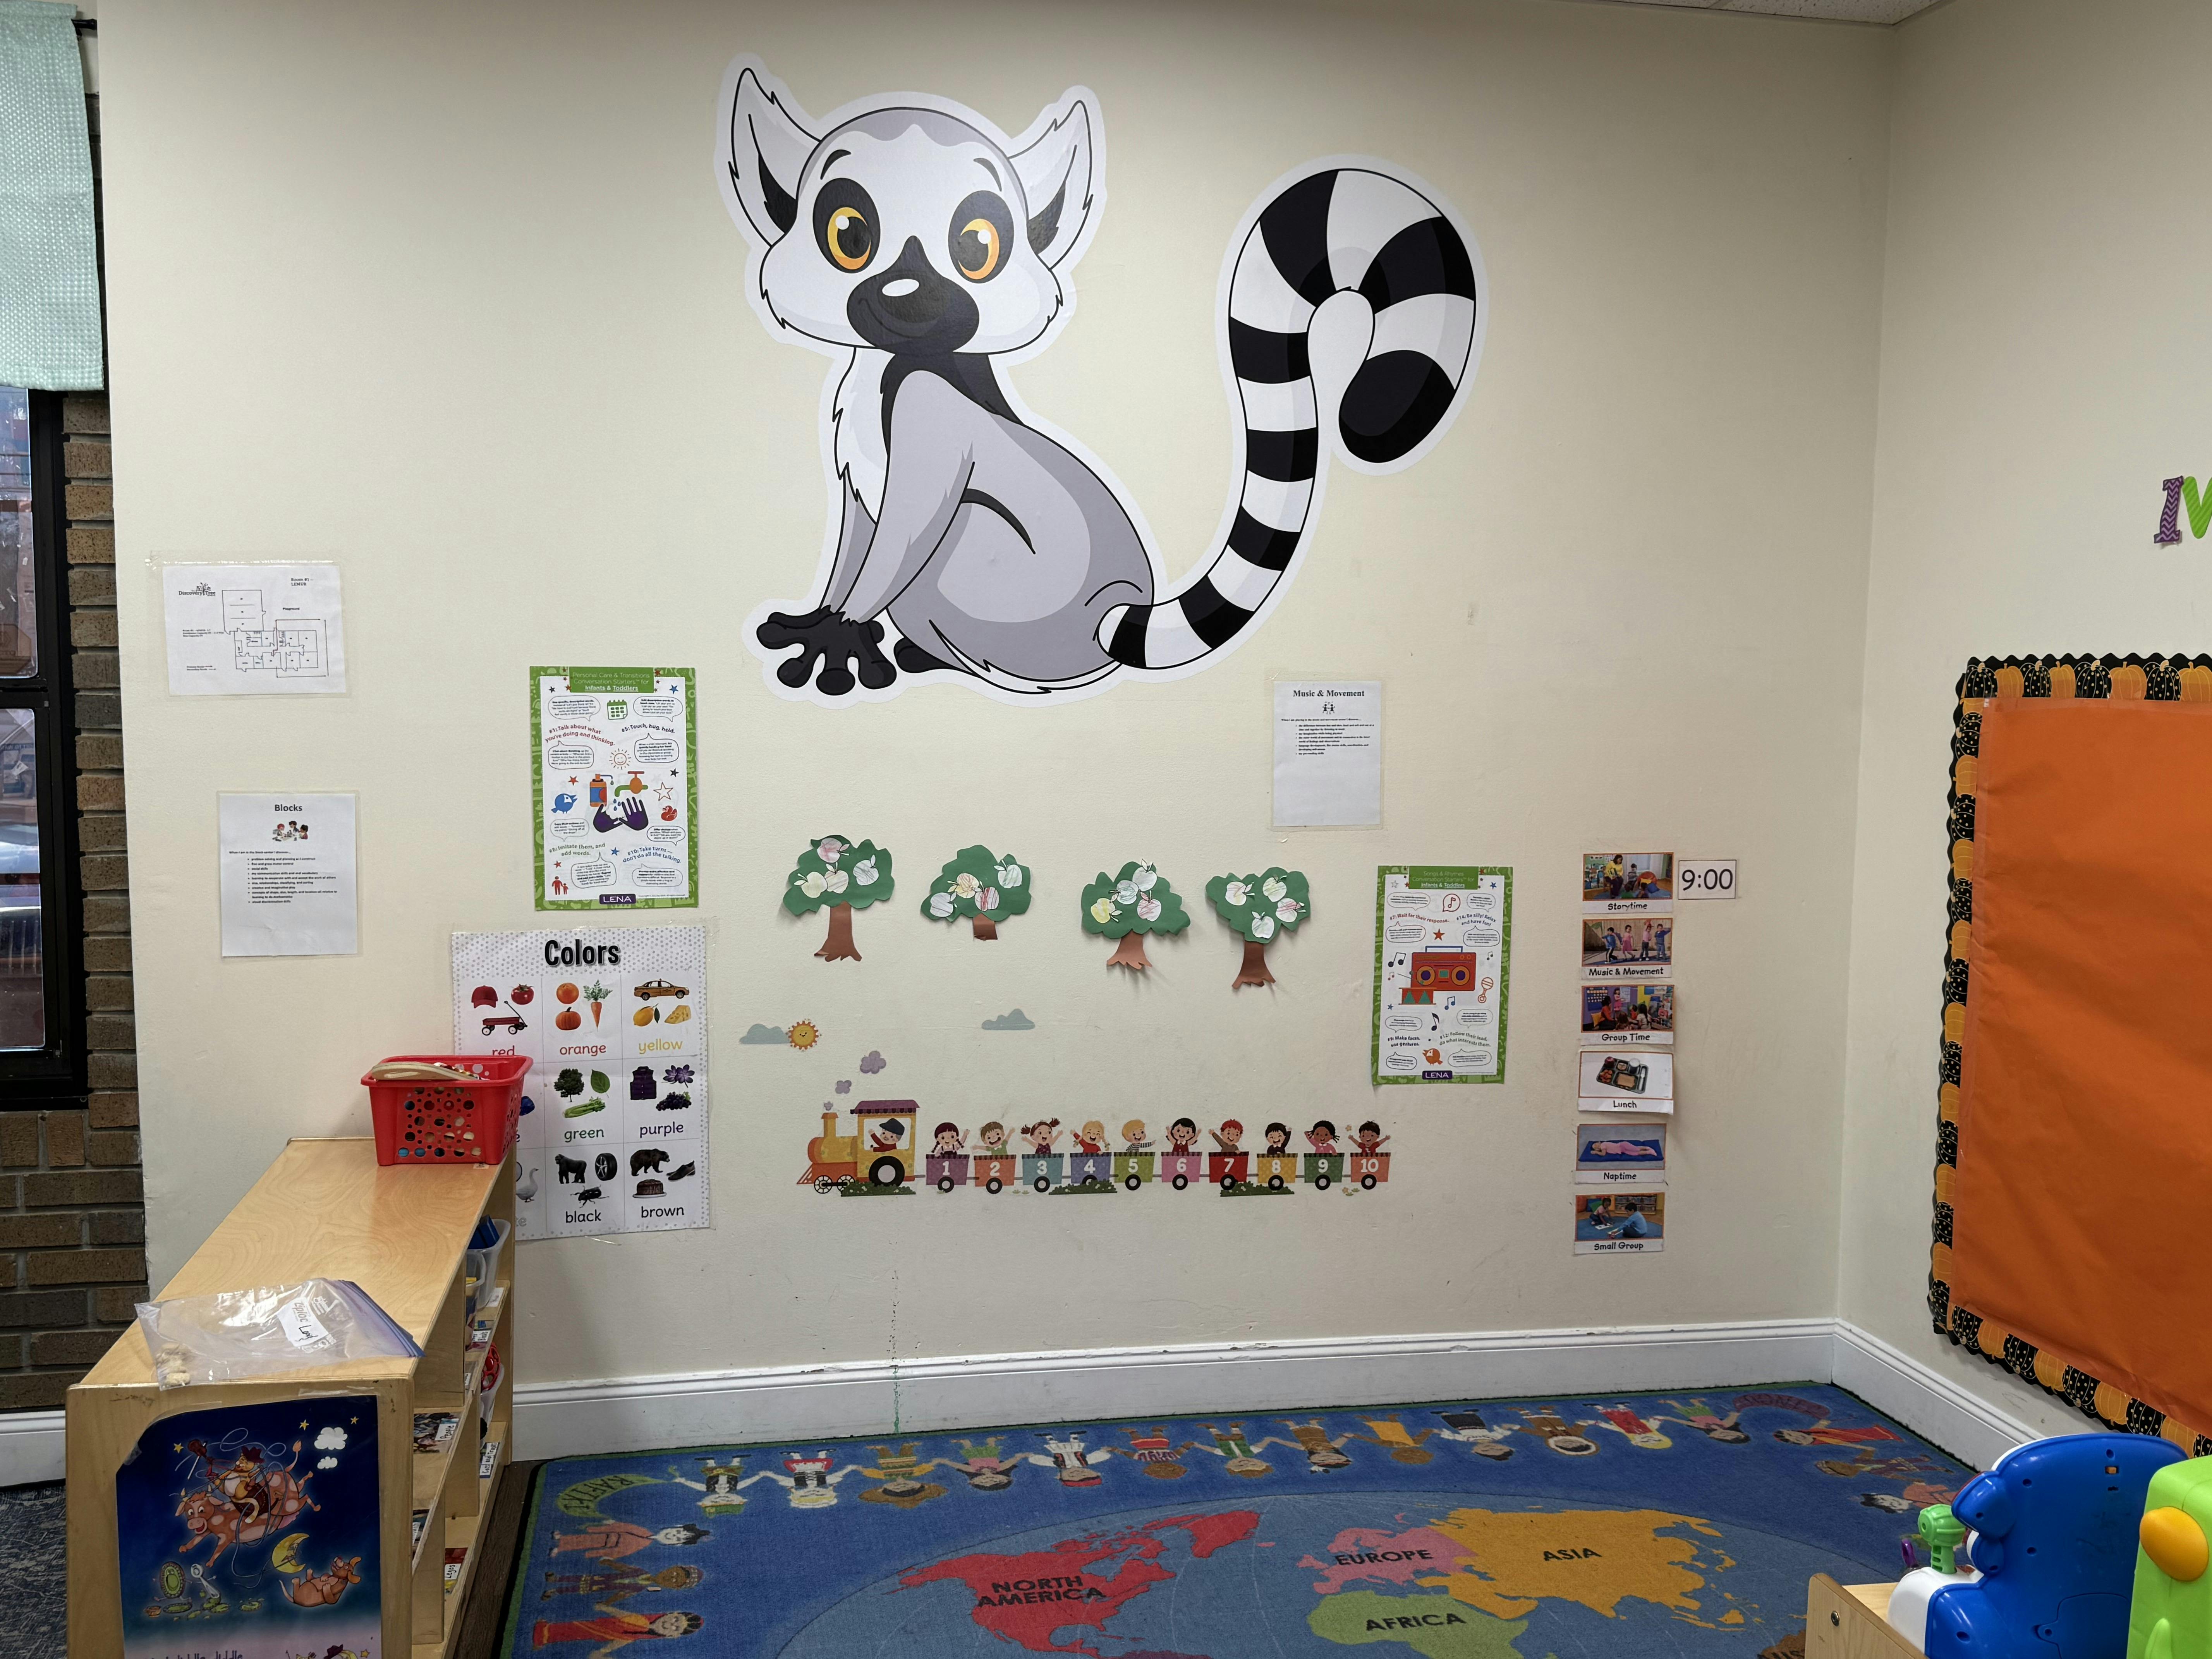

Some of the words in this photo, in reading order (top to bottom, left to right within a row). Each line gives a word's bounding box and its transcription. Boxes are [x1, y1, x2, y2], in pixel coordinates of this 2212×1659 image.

[588, 726, 601, 735] what
[545, 733, 562, 743] you're
[591, 733, 615, 746] thinking.
[275, 804, 303, 812] Blocks
[663, 854, 682, 863] talking.
[1682, 869, 1733, 891] 9:00
[1607, 903, 1648, 911] Storytime
[544, 939, 620, 966] Colors
[1589, 968, 1613, 976] Music
[1623, 967, 1664, 975] Movement
[1602, 1034, 1628, 1042] Group
[492, 1046, 515, 1056] red
[560, 1043, 606, 1056] orange
[639, 1039, 683, 1054] yellow
[564, 1128, 604, 1142] green
[640, 1121, 684, 1138] purple
[942, 1161, 950, 1175] 1
[990, 1162, 1000, 1176] 2
[1037, 1160, 1048, 1175] 3
[1084, 1160, 1096, 1174] 4
[1128, 1159, 1139, 1172] 5
[1176, 1159, 1187, 1172] 6
[1224, 1159, 1235, 1172] 7
[1272, 1159, 1281, 1173] 8
[1318, 1159, 1328, 1173] 9
[1360, 1159, 1379, 1173] 10
[1603, 1172, 1637, 1181] Naptime
[565, 1210, 601, 1223] black
[641, 1206, 684, 1218] brown
[1594, 1242, 1616, 1250] Small
[1618, 1242, 1644, 1250] Group
[1334, 1548, 1434, 1566] EUROPE
[1542, 1547, 1602, 1562] ASIA
[991, 1576, 1084, 1594] NORTH
[976, 1586, 1106, 1607] AMERICA
[1365, 1612, 1467, 1632] AFRICA
